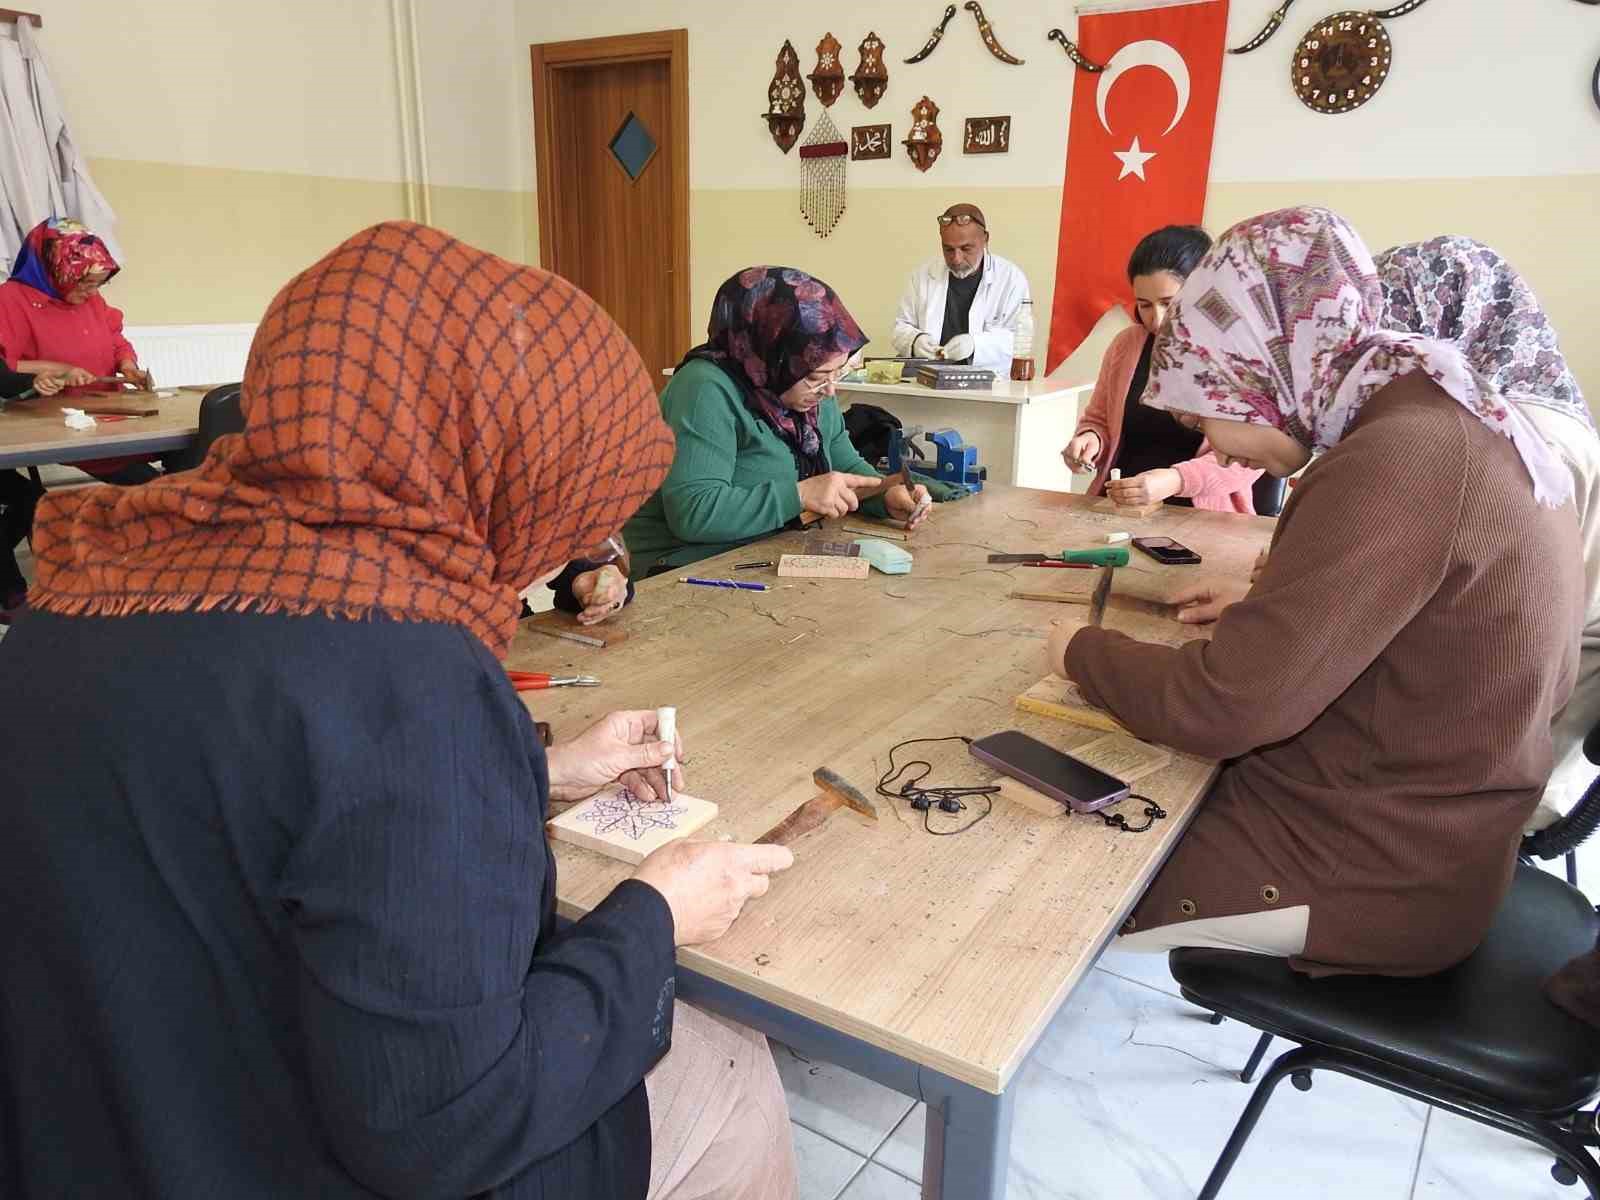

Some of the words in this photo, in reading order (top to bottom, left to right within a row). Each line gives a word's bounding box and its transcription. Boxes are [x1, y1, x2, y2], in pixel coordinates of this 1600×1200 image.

[1321, 26, 1334, 36] 11
[1339, 21, 1353, 31] 12
[1359, 25, 1366, 35] 1
[1305, 40, 1319, 50] 10
[1367, 38, 1377, 48] 2
[1301, 58, 1309, 68] 9
[1370, 57, 1378, 66] 3
[1302, 76, 1310, 85] 8
[1362, 75, 1371, 85] 4
[1312, 89, 1320, 99] 7
[1328, 94, 1336, 103] 6
[1347, 89, 1355, 99] 5
